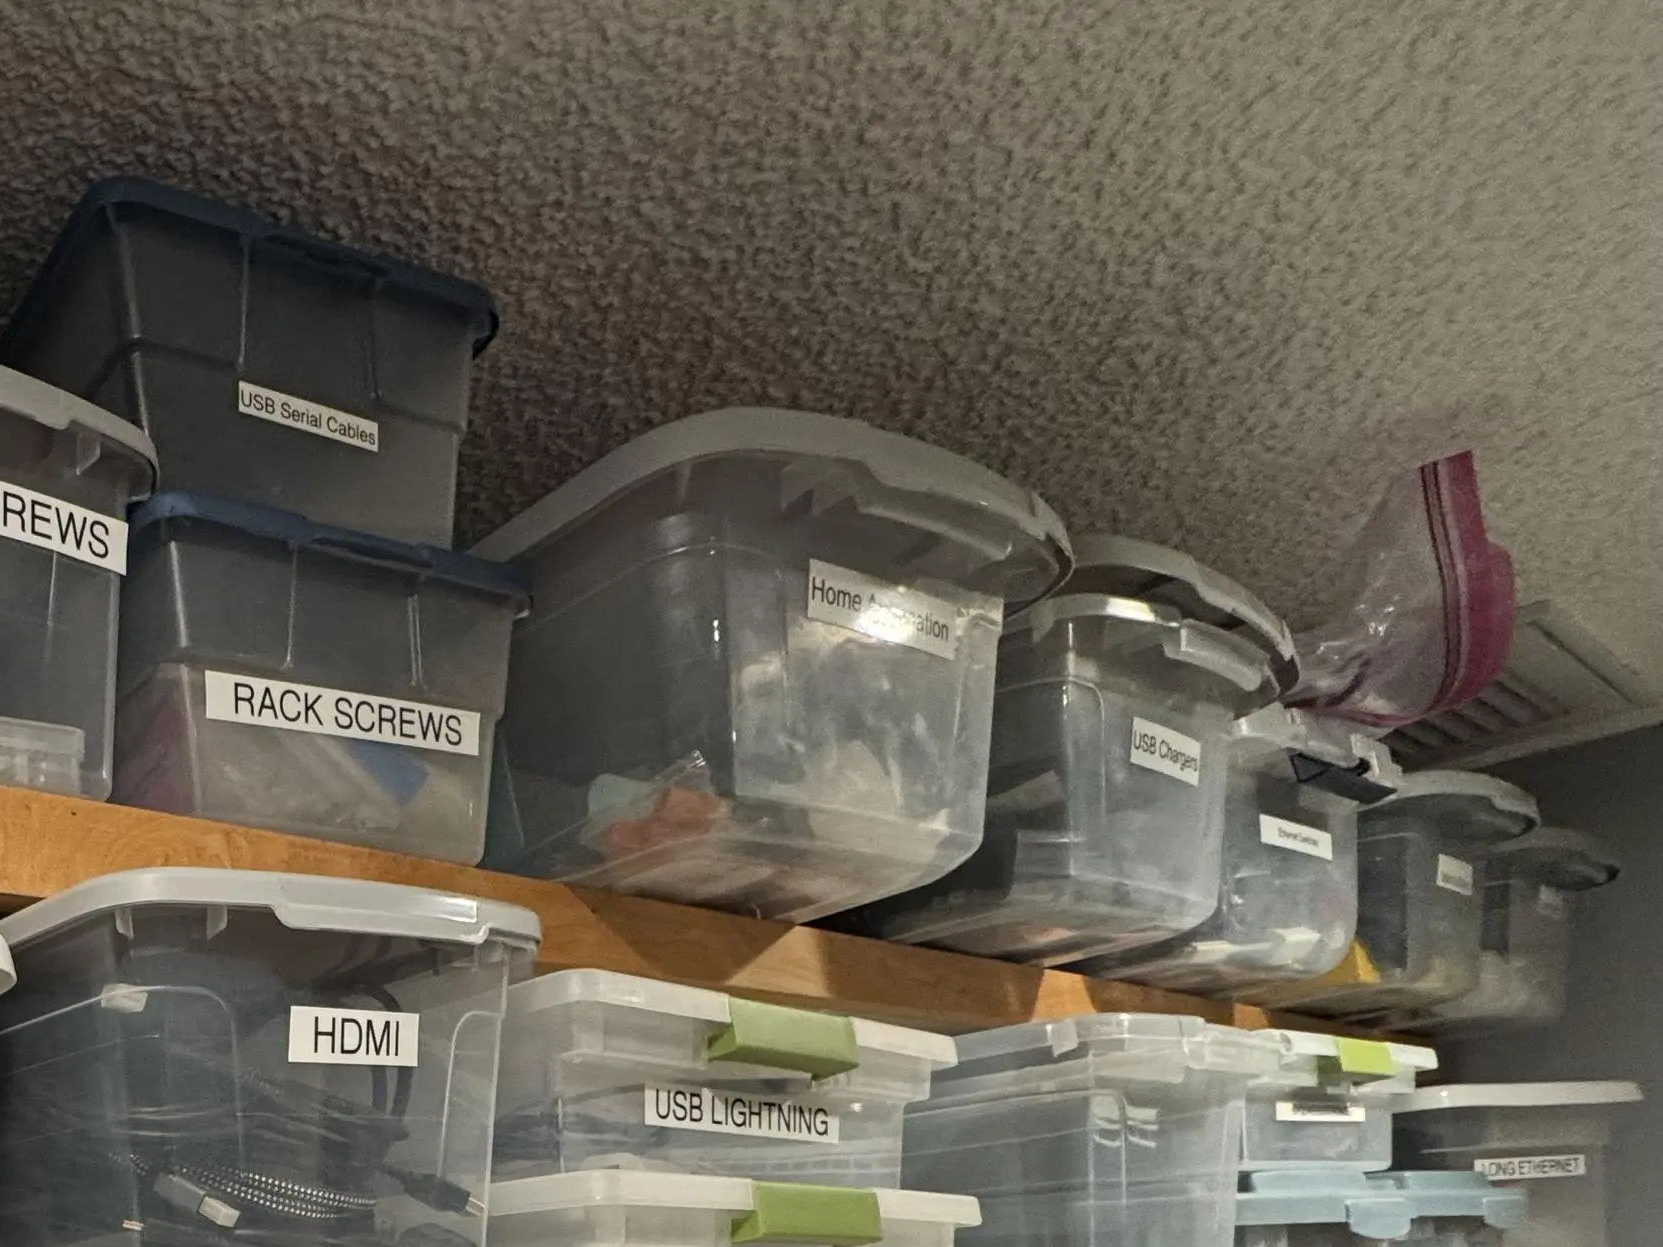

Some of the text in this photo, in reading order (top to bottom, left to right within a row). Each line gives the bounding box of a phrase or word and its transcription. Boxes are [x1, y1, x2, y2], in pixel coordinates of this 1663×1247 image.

[241, 389, 376, 445] USB Serial Cables
[812, 576, 862, 611] Home
[234, 682, 462, 746] RACK SCREWS
[1134, 730, 1156, 755] USB
[313, 1016, 400, 1057] HDMI
[656, 1088, 829, 1137] USB LIGHTNING
